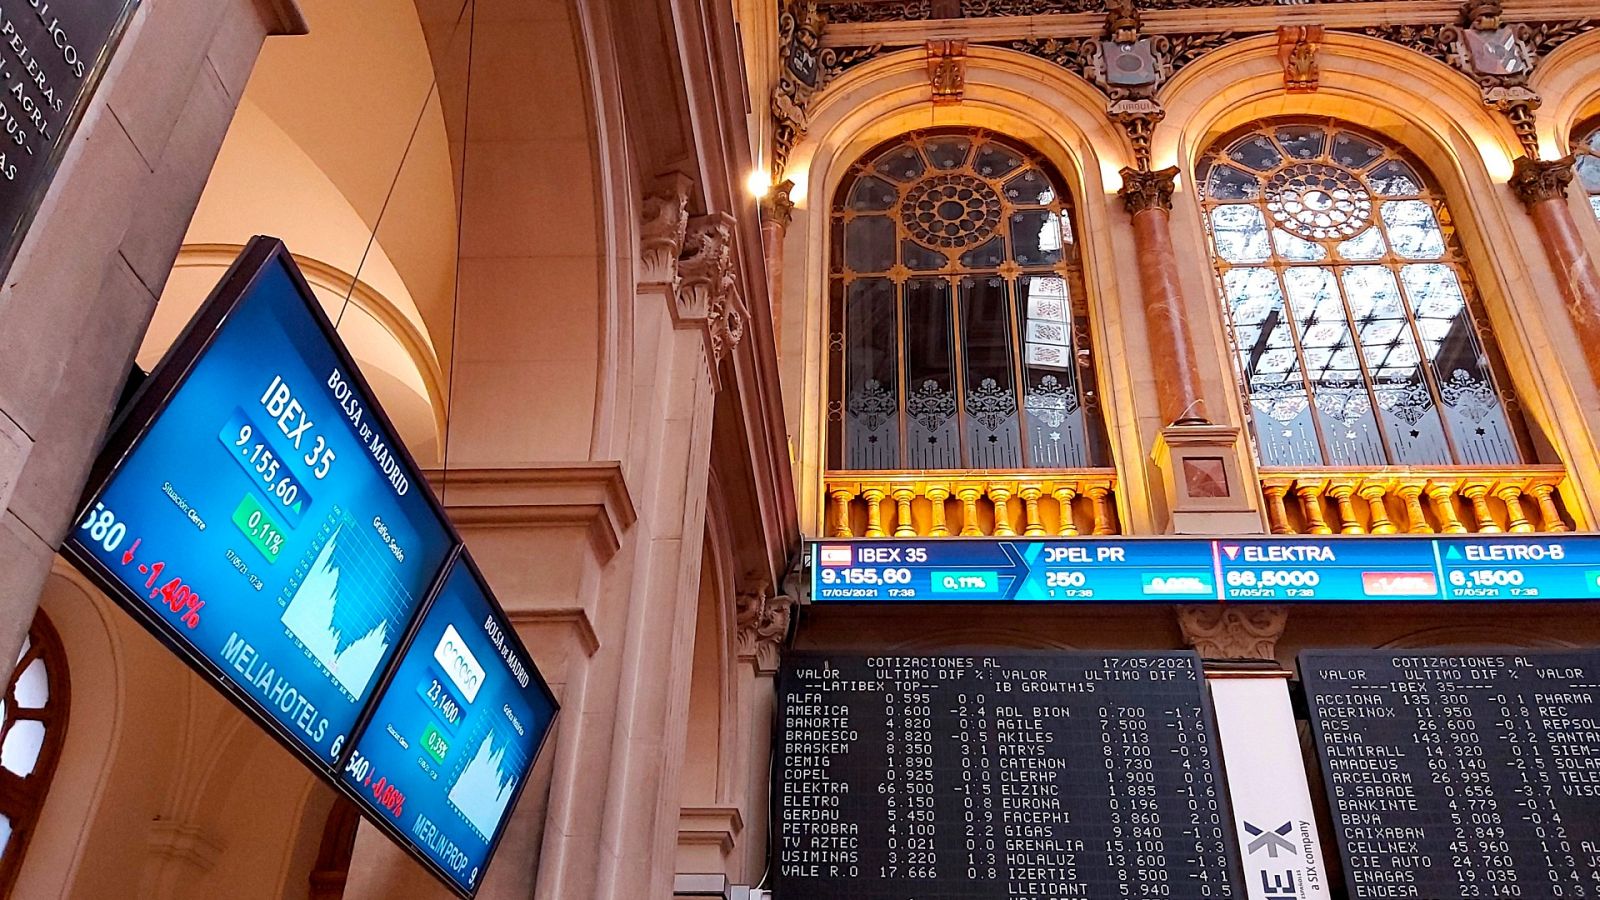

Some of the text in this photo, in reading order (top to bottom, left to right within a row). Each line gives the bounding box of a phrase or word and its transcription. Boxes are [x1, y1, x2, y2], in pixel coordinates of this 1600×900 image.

[11, 82, 51, 140] AGRI-
[260, 375, 314, 450] IBEX
[304, 435, 336, 480] 35
[327, 368, 409, 496] BOLSA DE MADRID
[235, 425, 298, 506] 9.155,60
[188, 509, 206, 530] Cierre
[248, 511, 284, 555] 0,11%
[858, 547, 928, 563] IBEX 35
[1097, 546, 1126, 562] PR
[1243, 546, 1336, 562] ELEKTRA
[1464, 544, 1566, 561] ELETRO-B
[821, 568, 912, 586] 9.155,60
[1226, 570, 1320, 588] 66,5000
[1449, 570, 1525, 588] 6,1500
[138, 562, 205, 628] -1,40%
[821, 589, 915, 597] 17/05/2021 17:38
[1229, 589, 1275, 597] 17/05/21
[1452, 588, 1499, 597] 17/05/21
[484, 614, 505, 650] BOLSA
[506, 649, 529, 688] MADRID
[868, 658, 1000, 667] COTIZACIONES AL
[1104, 659, 1192, 668] 17/05/2021
[1392, 657, 1533, 667] COTIZACIONES AL
[797, 669, 964, 679] VALOR ULTIMO DIF
[1003, 670, 1175, 680] VALOR ULTIMO DIF
[1320, 669, 1584, 680] VALOR ULTIMO DIF VALOR
[220, 632, 329, 743] MELIAHOTELS
[996, 682, 1094, 692] IB GROWTH15
[426, 680, 459, 724] 23,1400
[788, 694, 929, 703] ALFA 0.595
[1316, 694, 1592, 705] ACCIONA 135.300 PHARMA
[787, 706, 930, 716] AMERICA 0.600
[996, 707, 1069, 717] ADL BION
[1319, 707, 1567, 717] ACERINOX REC
[787, 718, 848, 728] BANORTE
[997, 720, 1146, 730] AGILE 7.500
[1322, 719, 1600, 730] ACS 26.600 REPSOL
[786, 731, 931, 741] BRADESCO 3.820
[998, 732, 1148, 743] AKILES 0.113
[1324, 733, 1478, 743] AENA 143.900
[786, 743, 931, 754] BRASKEM 8.350
[999, 745, 1044, 755] ATRYS
[1327, 746, 1405, 756] ALMIRALL
[786, 756, 829, 766] CEMIG
[1000, 758, 1152, 769] CATENON 0.730
[1330, 759, 1486, 769] AMADEUS 60.140
[785, 769, 932, 780] COPEL 0.925
[1001, 772, 1154, 782] CLERHP 1.900
[1333, 772, 1489, 783] ARCELORM 26.995
[785, 783, 933, 793] ELEKTRA 66.500
[1002, 785, 1058, 795] ELZINC
[1336, 786, 1414, 796] B.SABADE
[784, 796, 838, 806] ELETRO
[1003, 798, 1157, 809] EURONA 0.196
[1338, 800, 1496, 810] BANKINTE 4.779
[784, 810, 934, 821] GERDAU 5.450
[1004, 812, 1159, 823] FACEPHI 3.860
[1342, 813, 1501, 824] BBVA 5.008
[783, 823, 934, 835] PETROBRA 4.100
[1005, 826, 1052, 836] GIGAS
[1345, 828, 1424, 839] CAIXABAN
[784, 837, 857, 848] TV AZTEC
[1006, 840, 1163, 852] GRENALIA 15.100
[1298, 820, 1315, 865] company
[1348, 842, 1509, 853] CELLNEX 45.960
[782, 851, 936, 863] USIMINAS 3.220
[1007, 854, 1165, 866] HOLALUZ 13.600
[1351, 856, 1512, 867] CIE AUTO 24.760
[782, 866, 818, 876] VALE
[881, 867, 936, 878] 17.666
[1010, 868, 1076, 880] IZERTIS
[1306, 866, 1319, 885] SIX
[1354, 871, 1414, 882] ENAGAS
[1009, 883, 1169, 895] LLEIDANT 5.940
[1357, 885, 1520, 897] ENDESA 23.140
